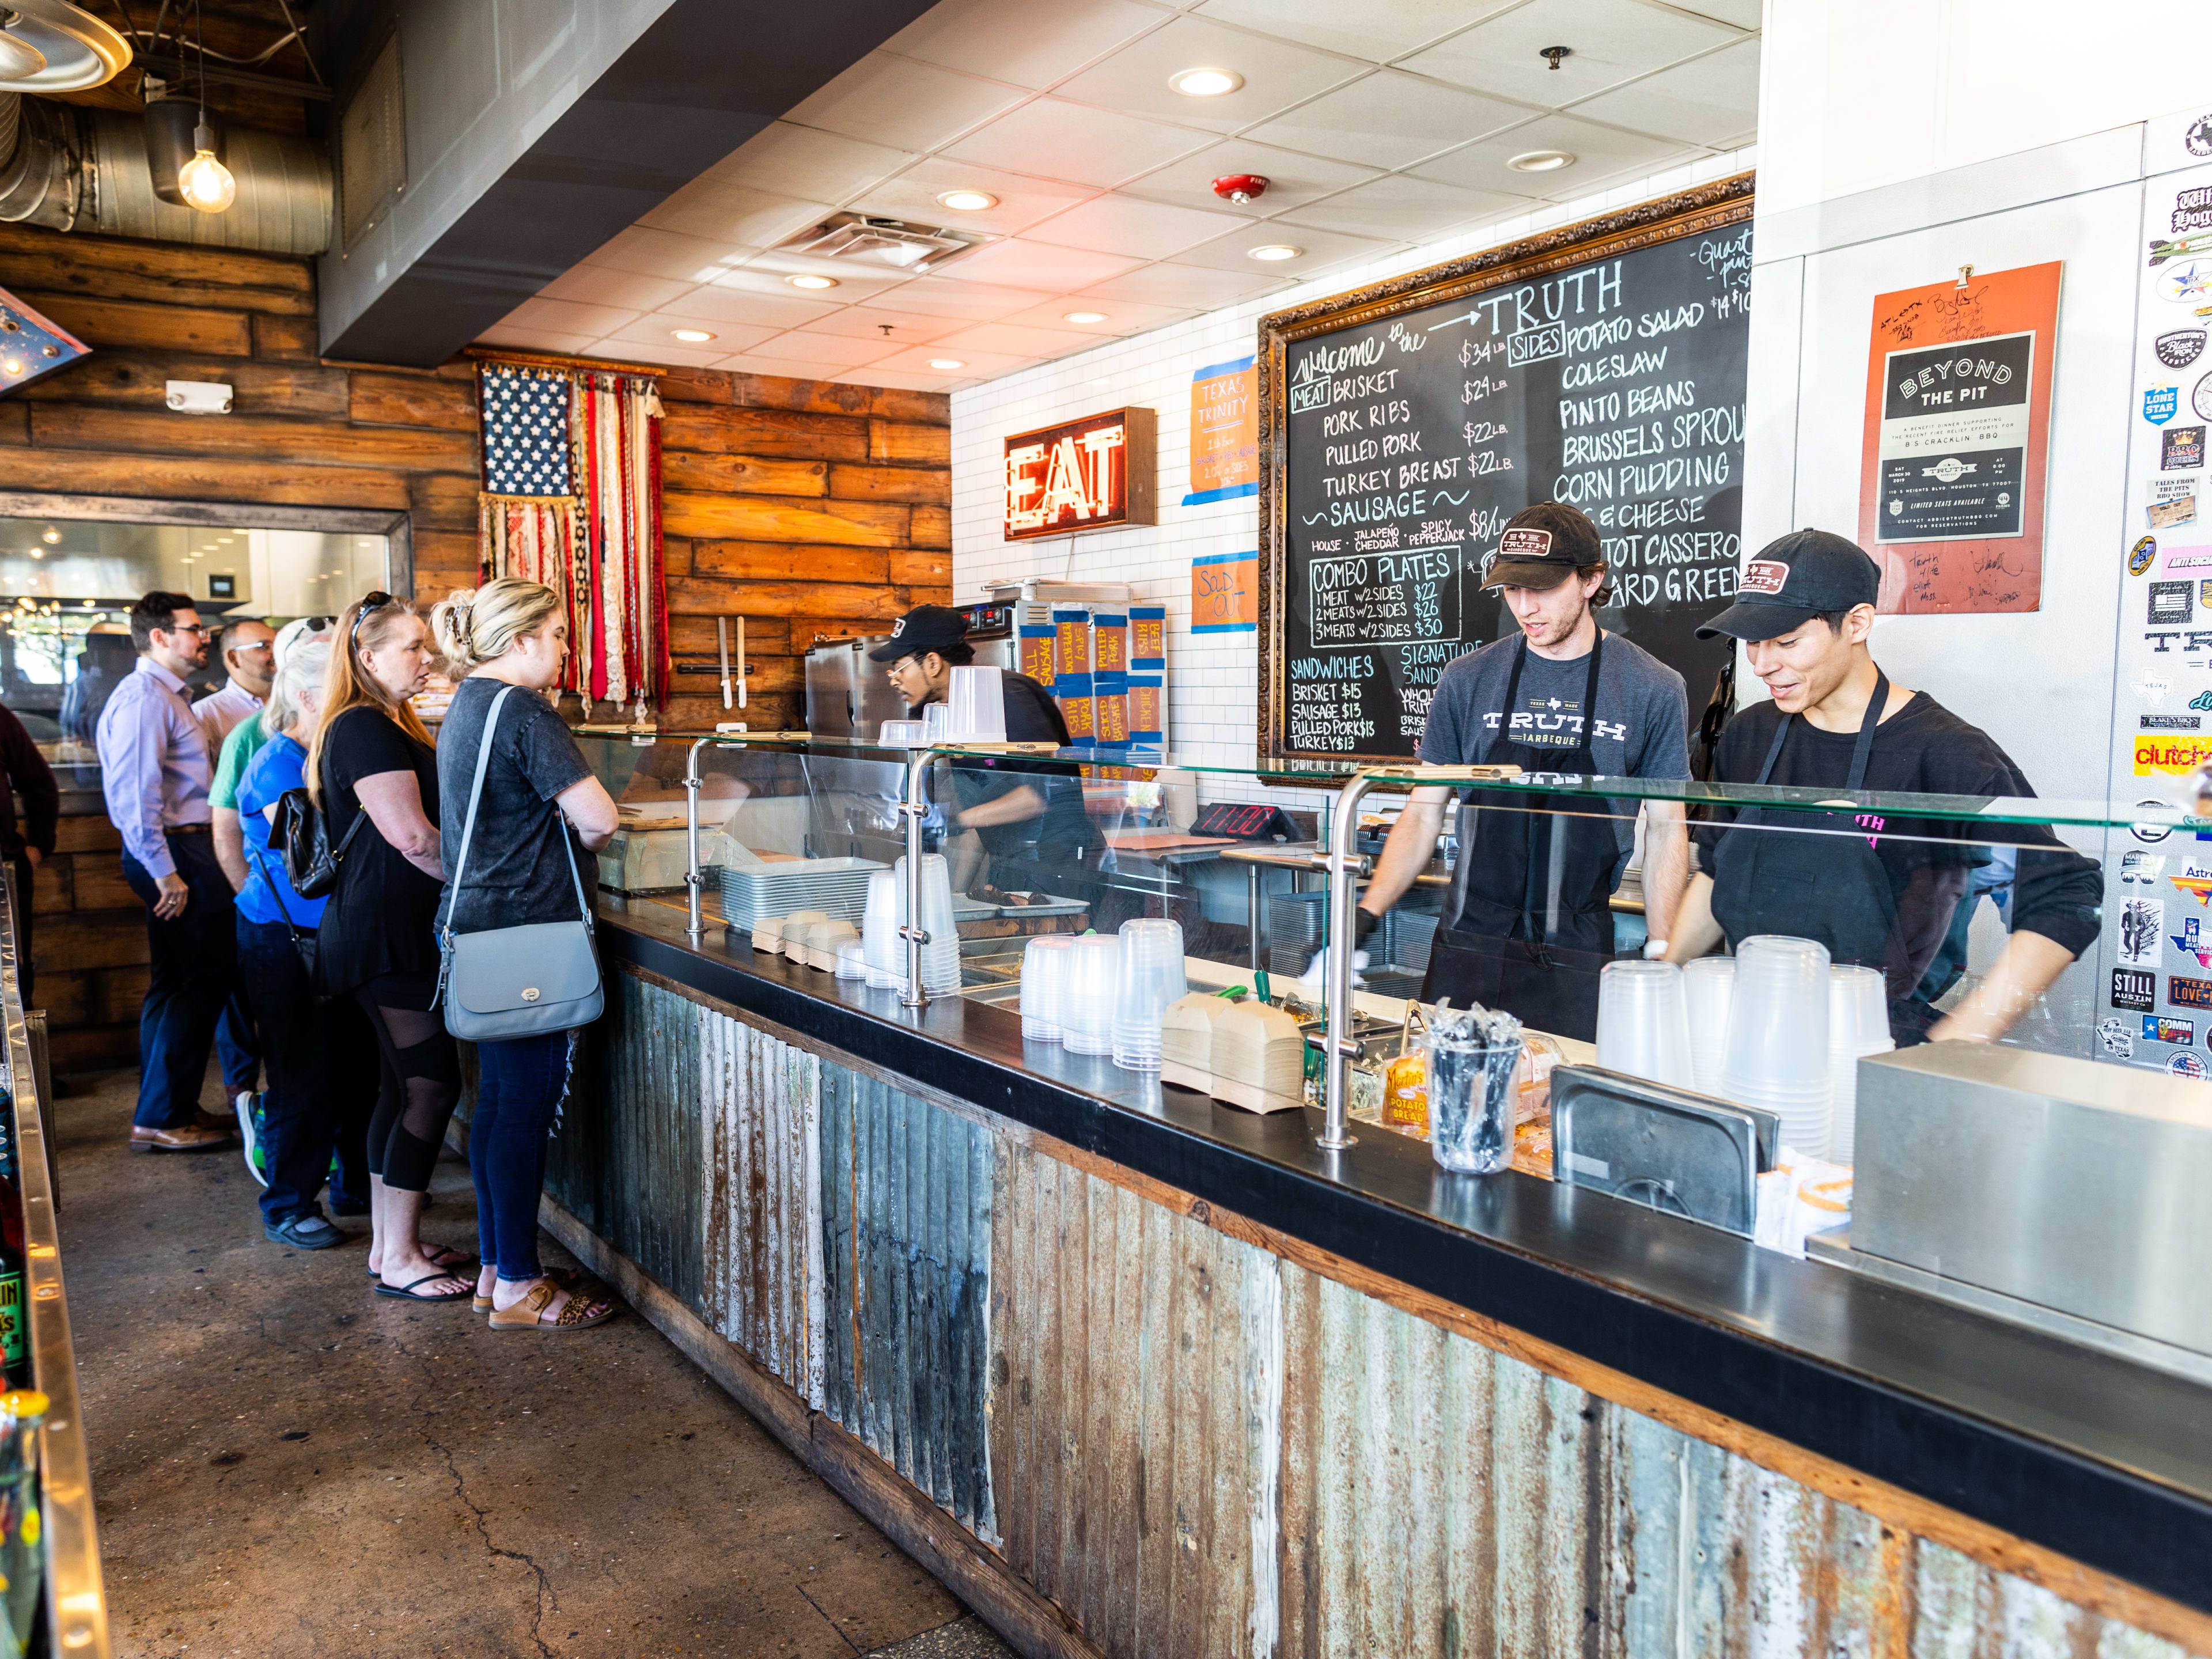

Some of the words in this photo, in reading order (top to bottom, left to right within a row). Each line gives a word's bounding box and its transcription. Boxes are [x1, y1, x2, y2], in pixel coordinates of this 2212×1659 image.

[1478, 260, 1622, 335] TRUTH
[1710, 295, 1729, 319] $14
[1388, 323, 1404, 342] to
[1399, 331, 1426, 353] the
[1512, 326, 1560, 361] SIDES
[1567, 315, 1632, 358] POTATO
[1637, 302, 1704, 338] SALAD
[1333, 369, 1399, 403] BRISKET
[1459, 339, 1490, 368] $34
[1562, 346, 1668, 390] COLESLAW
[1899, 358, 2012, 399] BEYOND
[1202, 376, 1245, 403] TEXAS
[1294, 384, 1325, 410] MEAT
[1921, 390, 1953, 406] THE
[1960, 386, 1987, 402] PIT
[2146, 393, 2175, 404] LONE
[1198, 393, 1249, 424] TRINITY
[1324, 410, 1362, 438] PORK
[1369, 400, 1410, 427] RIBS
[1461, 376, 1489, 405] $24
[1560, 392, 1620, 430] PINTO
[1627, 381, 1695, 418] BEANS
[2146, 403, 2174, 414] STAR
[1963, 417, 2002, 425] SUPPORTING
[1325, 438, 1378, 465] PULLED
[1382, 431, 1422, 458] PORK
[1463, 421, 1494, 447] $22
[1563, 421, 1664, 468] BRUSSELS
[1672, 403, 1746, 449] SPROU
[2166, 456, 2199, 465] QUEEN
[2167, 444, 2200, 457] BBQ
[1003, 424, 1124, 531] EAT
[1323, 468, 1391, 497] TURKEY
[1399, 457, 1461, 489] BREAST
[1468, 450, 1495, 478] $22
[1554, 467, 1612, 503] CORN
[1620, 452, 1729, 497] PUDDING
[1929, 466, 1969, 474] TRUTH
[1331, 490, 1426, 527] SAUSAGE
[1619, 495, 1705, 528] CHEESE
[1911, 501, 1932, 509] LIMITED
[1953, 498, 1985, 506] AVAILABLE
[1409, 529, 1465, 546] PEPPERJACK
[1421, 519, 1452, 533] SPICY
[1311, 539, 1342, 552] HOUSE
[1355, 537, 1400, 552] CHEDDAR
[1504, 541, 1547, 550] TRUTH
[1645, 531, 1741, 566] CASSERO
[1198, 571, 1234, 596] SOLD
[1313, 559, 1368, 592] COMBO
[1378, 553, 1450, 584] PLATES
[1212, 591, 1246, 618] OUT
[1414, 582, 1437, 602] $22
[1414, 600, 1438, 619] $26
[1137, 624, 1149, 654] RIBS
[1150, 623, 1161, 651] BEEF
[1415, 618, 1442, 637] $30
[1075, 628, 1085, 660] SPICY
[1098, 629, 1108, 667] PULLED
[1109, 635, 1118, 662] PORK
[1040, 637, 1053, 687] SAUSAGE
[1290, 655, 1374, 680] SANDWICHES
[1293, 683, 1336, 702] BRISKET
[1341, 682, 1362, 700] $15
[1067, 700, 1080, 733] RIBS
[1079, 698, 1092, 730] PORK
[1100, 700, 1111, 737] SLICED
[1111, 695, 1124, 741] BRISKET
[1139, 687, 1152, 732] CHICKEN
[1292, 704, 1339, 720] SAUSAGE
[1342, 702, 1361, 718] $13
[1292, 720, 1331, 737] PULLED
[1333, 718, 1361, 736] PORK
[1359, 719, 1375, 738] $13
[1483, 712, 1626, 741] TRUTH
[1290, 734, 1336, 750] TURKEY
[1336, 736, 1355, 751] $13
[1201, 806, 1275, 835] 11:00
[2115, 974, 2152, 995] STILL
[2115, 993, 2152, 1002] AUSTIN
[2175, 987, 2202, 1002] LOVE
[2169, 1054, 2188, 1064] SMOKIN
[1387, 1067, 1424, 1092] Martin's
[1391, 1097, 1426, 1112] POTATO
[1393, 1109, 1423, 1123] BREAD
